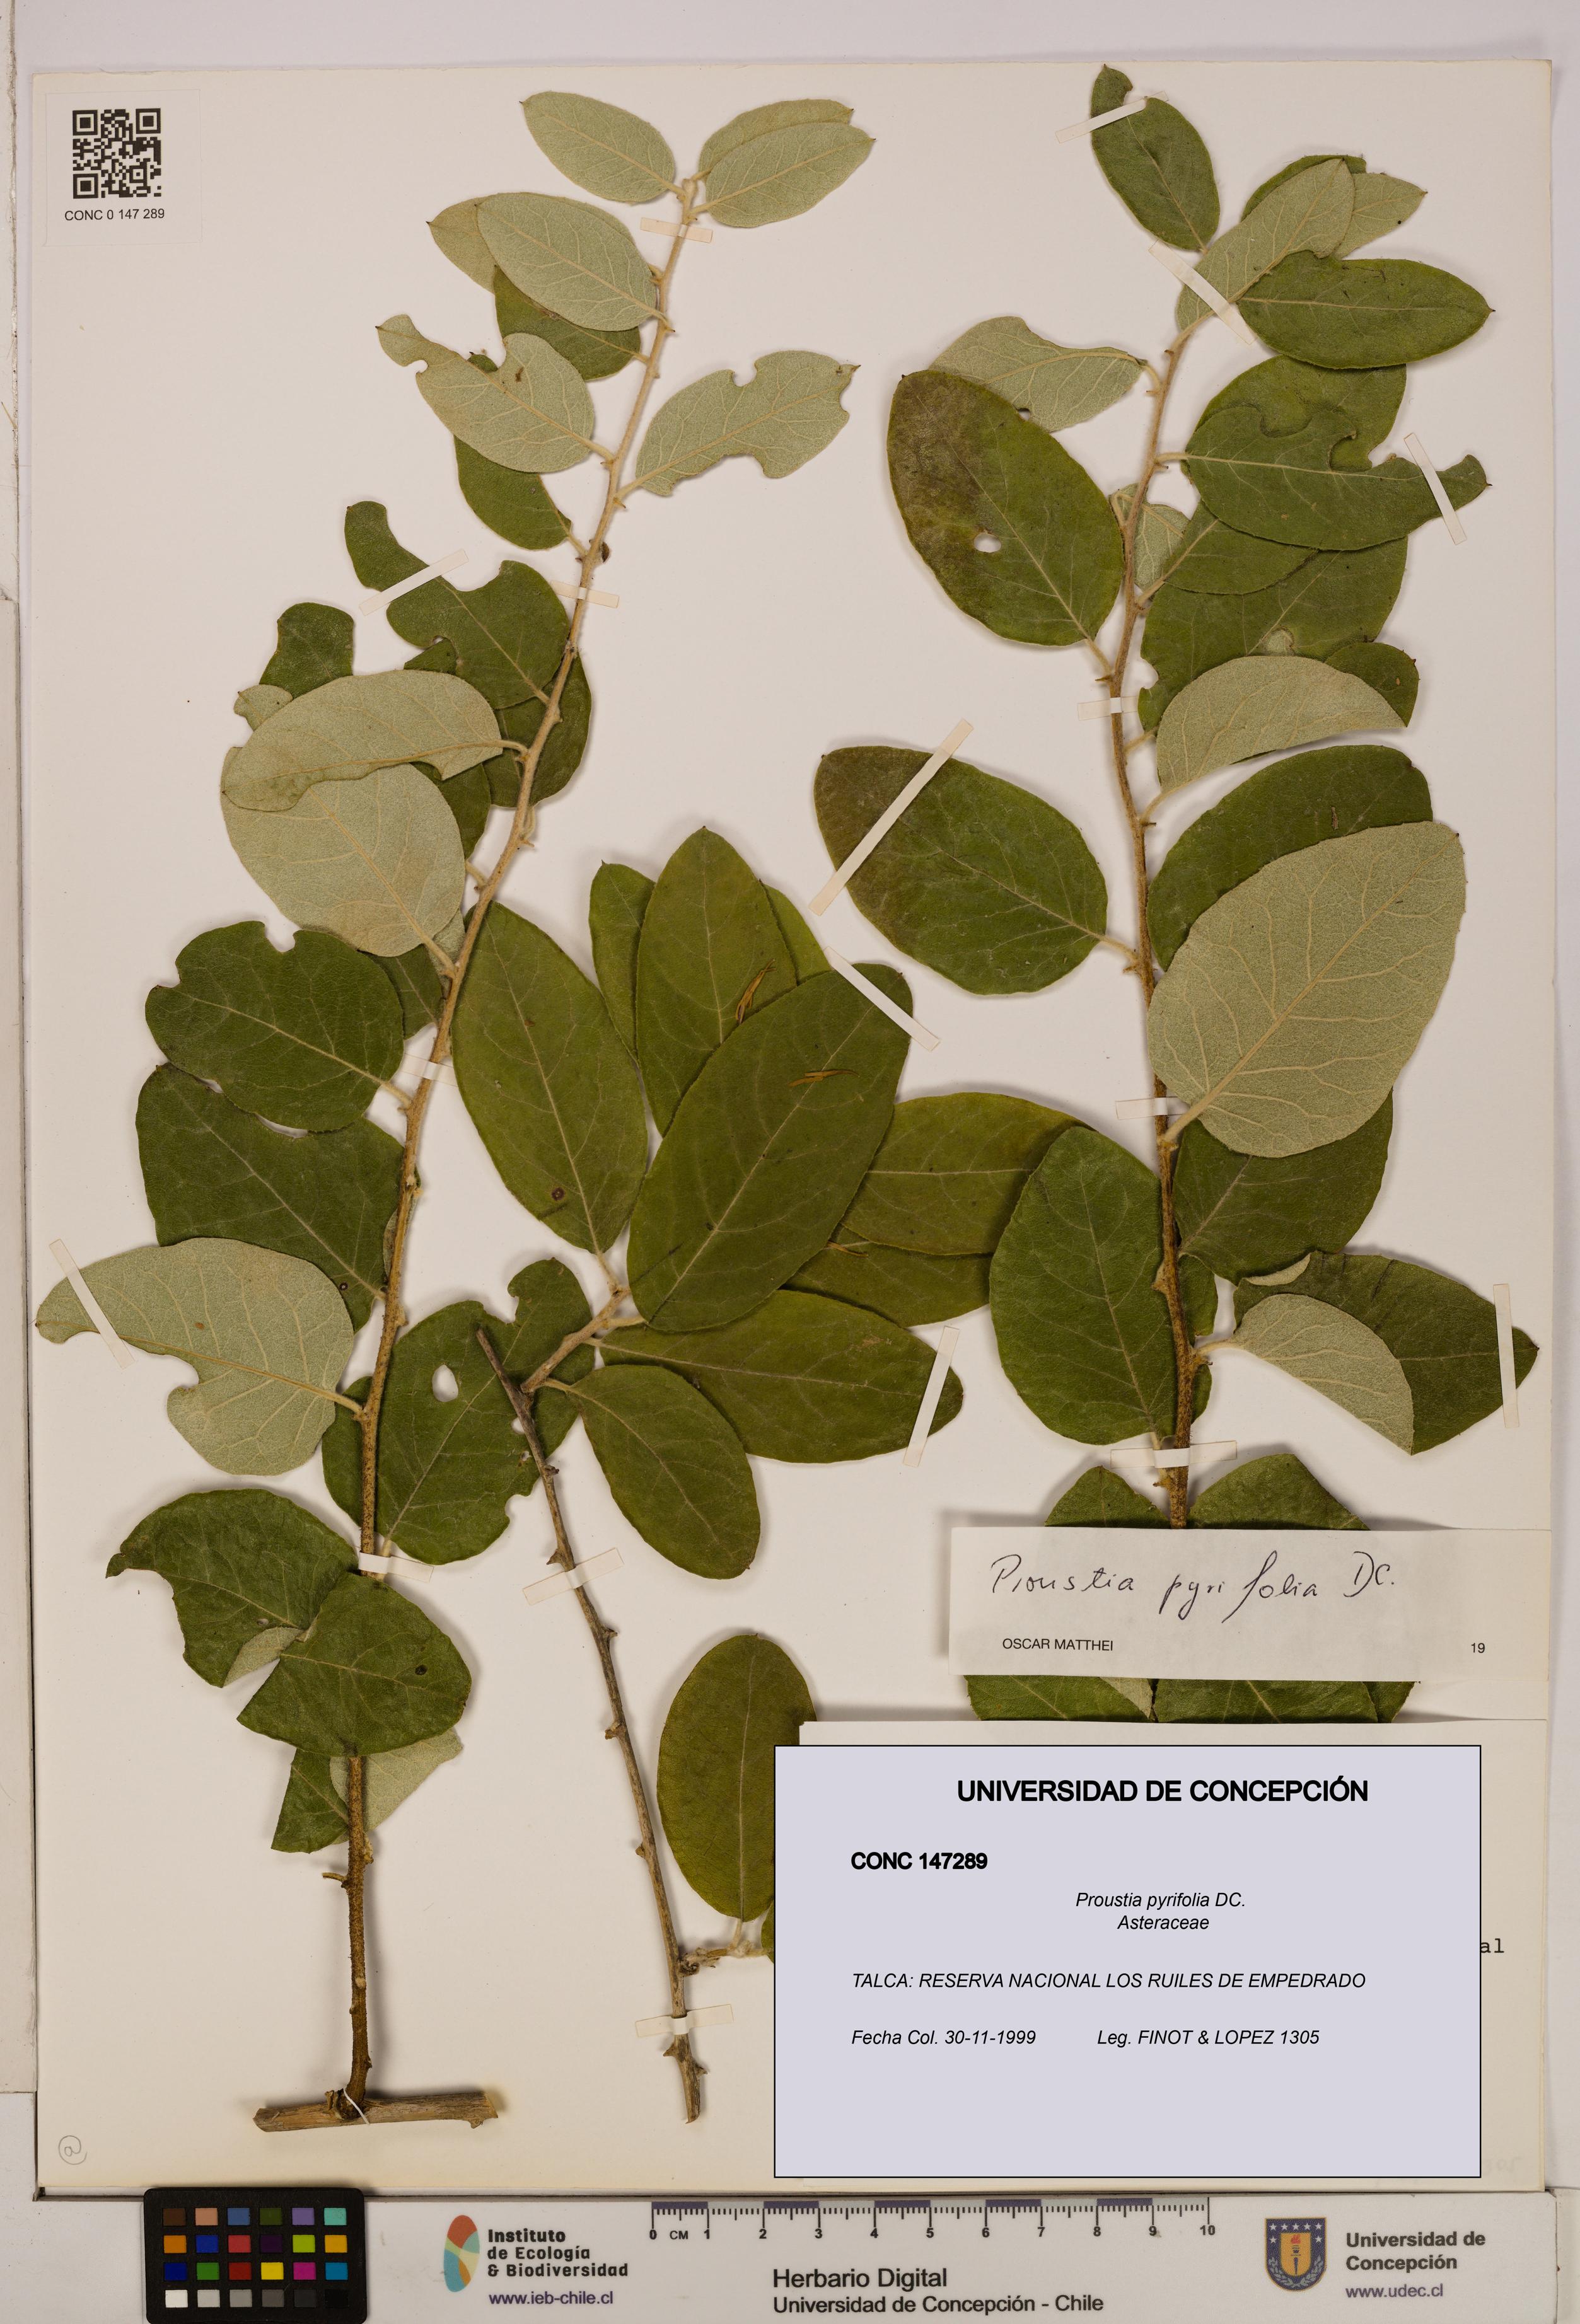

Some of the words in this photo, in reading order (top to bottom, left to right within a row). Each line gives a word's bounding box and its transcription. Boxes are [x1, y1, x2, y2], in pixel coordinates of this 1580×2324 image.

[64, 209, 103, 221] CONC
[107, 209, 114, 220] 0
[119, 209, 139, 219] 147
[143, 208, 165, 219] 289
[1002, 1638, 1050, 1650] OSCAR
[1054, 1638, 1113, 1651] MATTHEI
[1471, 1643, 1485, 1653] 19
[488, 2228, 566, 2243] Instituto
[649, 2229, 657, 2240] 0
[669, 2230, 688, 2240] CM
[704, 2229, 710, 2240] 1
[759, 2228, 767, 2240] 2
[815, 2228, 823, 2239] 3
[870, 2228, 879, 2239] 4
[926, 2228, 934, 2238] 5
[982, 2227, 990, 2238] 6
[1037, 2226, 1045, 2238] 7
[1093, 2226, 1101, 2237] 8
[1149, 2226, 1157, 2236] 9
[1200, 2224, 1216, 2236] 10
[1346, 2231, 1457, 2248] Universidad
[1463, 2231, 1486, 2246] de
[487, 2246, 508, 2260] de
[515, 2245, 590, 2262] Ecología
[487, 2263, 499, 2277] &
[506, 2262, 628, 2277] Biodiversidad
[1345, 2254, 1457, 2274] Concepción
[773, 2268, 870, 2288] Herbario
[878, 2267, 947, 2292] Digital
[489, 2291, 613, 2304] www.ieb-chile.cl
[1345, 2283, 1443, 2298] www.udec.cl
[774, 2296, 886, 2313] Universidad
[892, 2296, 916, 2313] de
[922, 2295, 1035, 2316] Concepción
[1055, 2294, 1104, 2311] Chile
